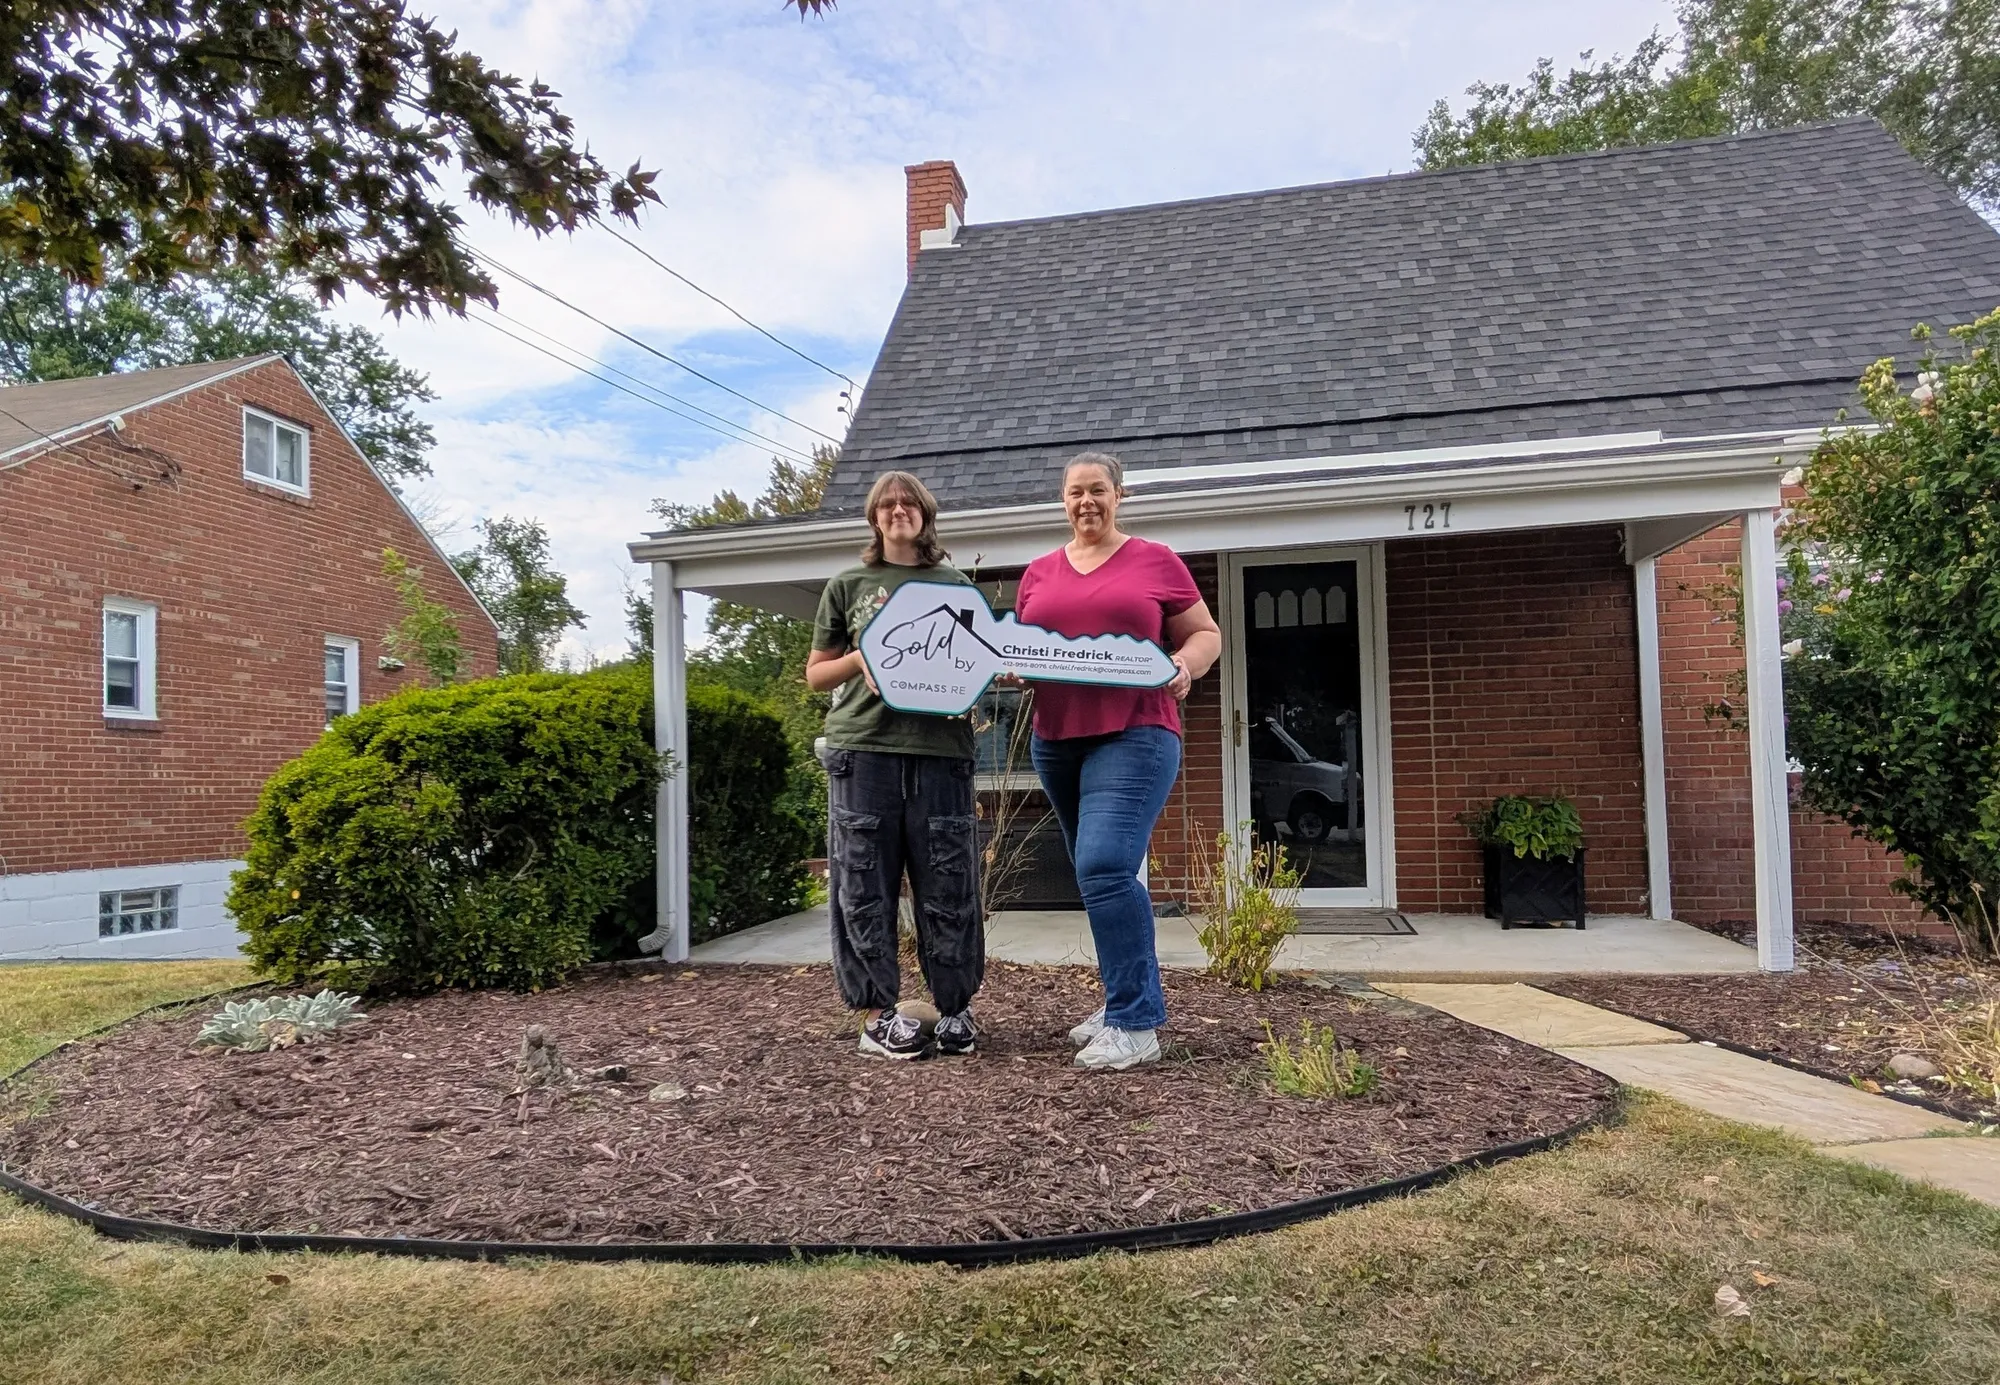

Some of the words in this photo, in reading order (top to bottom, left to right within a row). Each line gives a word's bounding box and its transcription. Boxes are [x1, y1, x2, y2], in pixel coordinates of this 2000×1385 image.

[1404, 501, 1452, 531] 727
[880, 620, 958, 670] Sold
[1002, 644, 1050, 657] Christi
[1053, 648, 1114, 661] Fredrick
[954, 656, 976, 673] by
[1048, 664, 1152, 676] christi.fredrick@compass.com
[890, 680, 948, 695] COMPASS
[950, 684, 967, 695] RE
